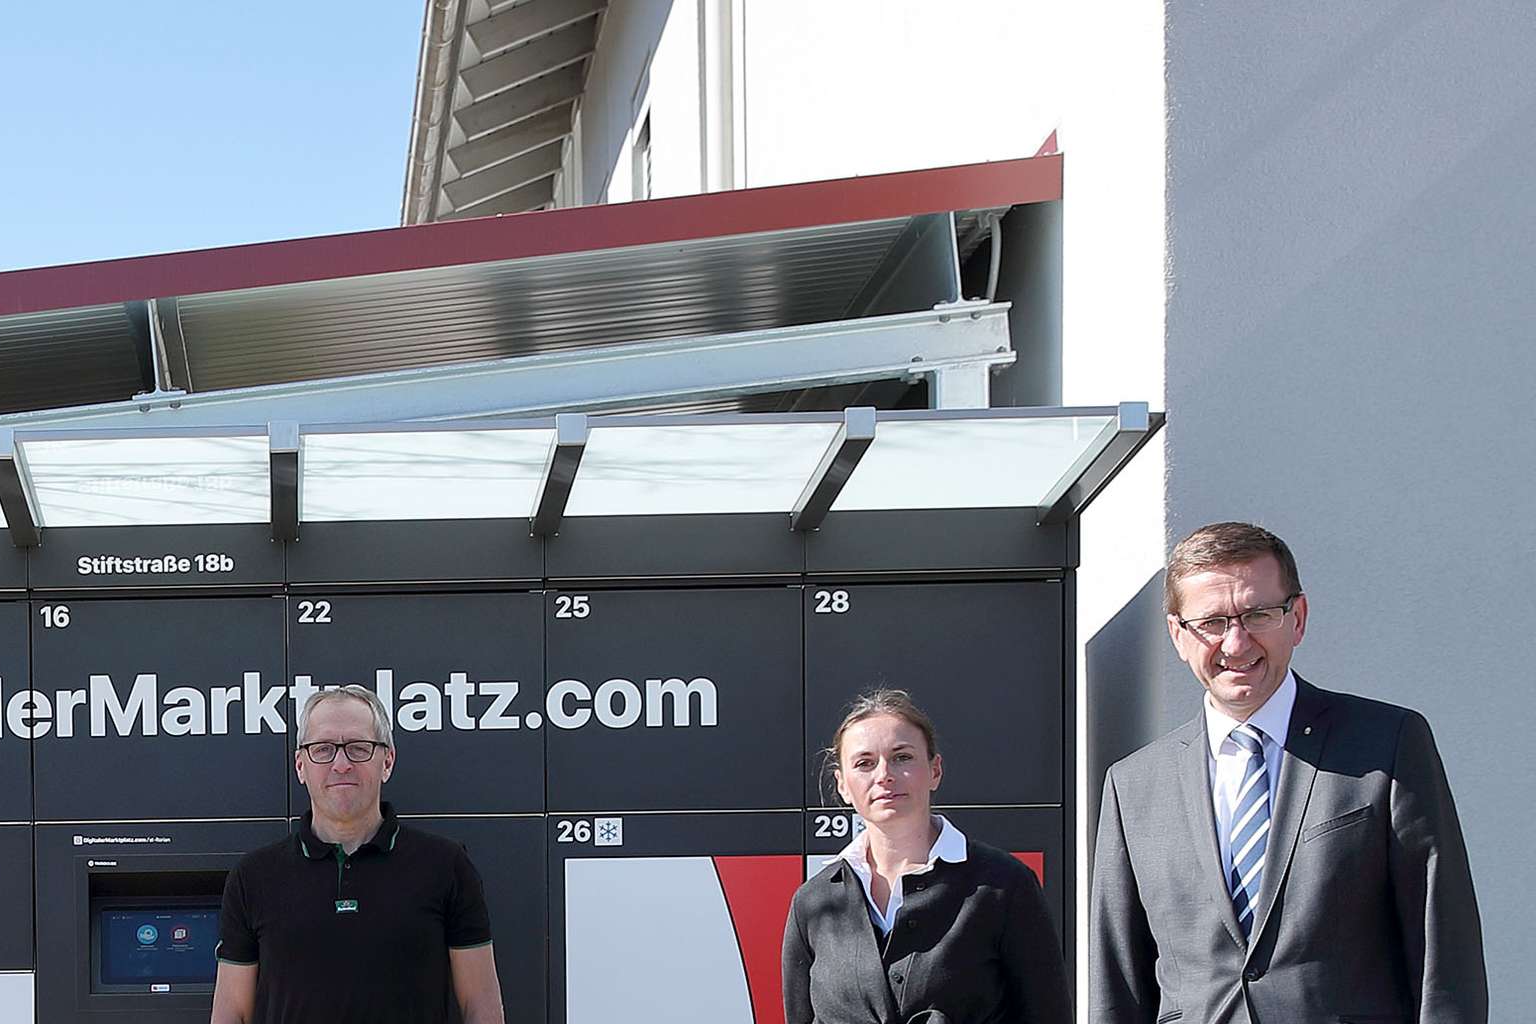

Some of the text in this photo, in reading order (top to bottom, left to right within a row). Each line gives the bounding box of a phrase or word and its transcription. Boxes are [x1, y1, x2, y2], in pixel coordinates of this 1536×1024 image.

[77, 554, 234, 574] Stiftstraße 18b
[298, 601, 332, 623] 22
[555, 595, 590, 618] 25
[814, 590, 850, 613] 28
[40, 605, 70, 628] 16
[557, 820, 591, 842] 26
[814, 815, 849, 838] 29
